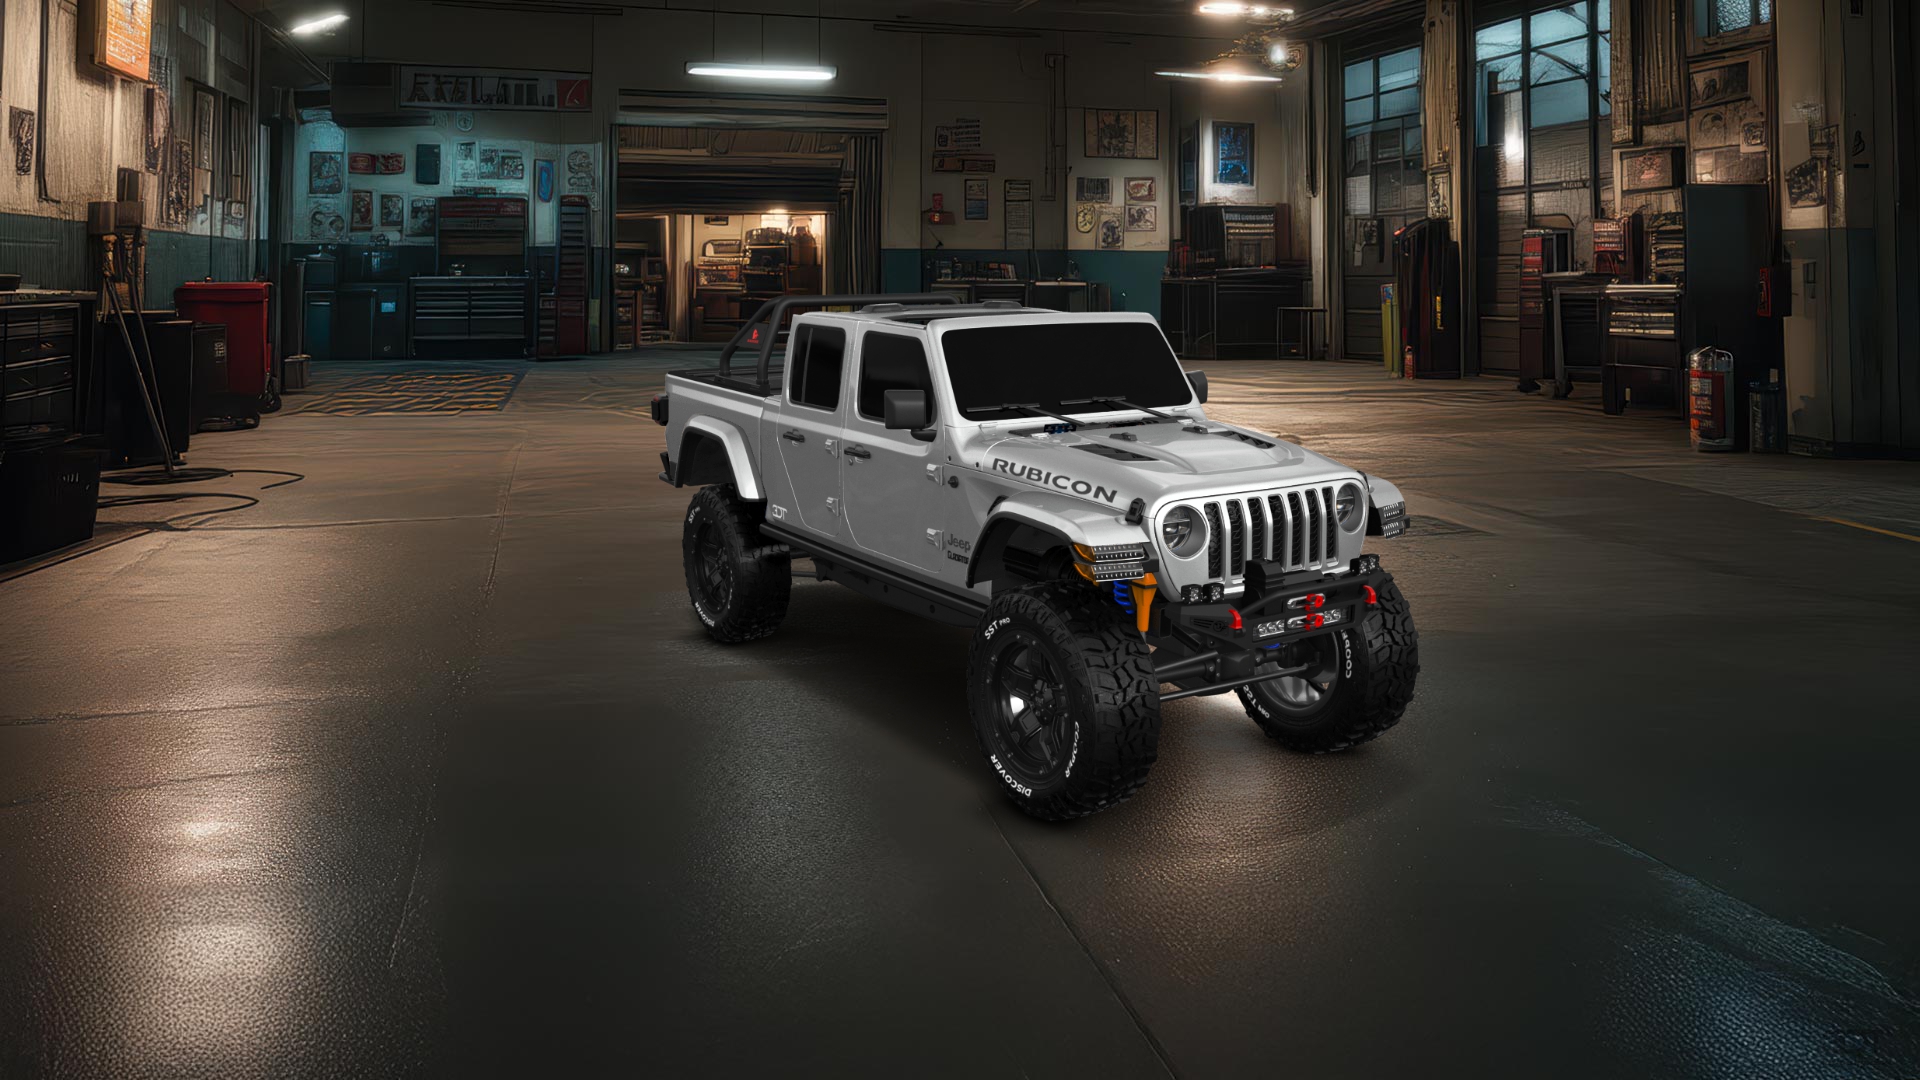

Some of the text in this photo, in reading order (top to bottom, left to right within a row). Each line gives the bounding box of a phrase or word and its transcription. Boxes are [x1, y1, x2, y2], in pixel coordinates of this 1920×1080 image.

[992, 458, 1117, 503] RUBICON
[947, 533, 971, 553] Jeep
[984, 617, 1011, 640] SST PRO
[990, 754, 1033, 797] DISCOVER
